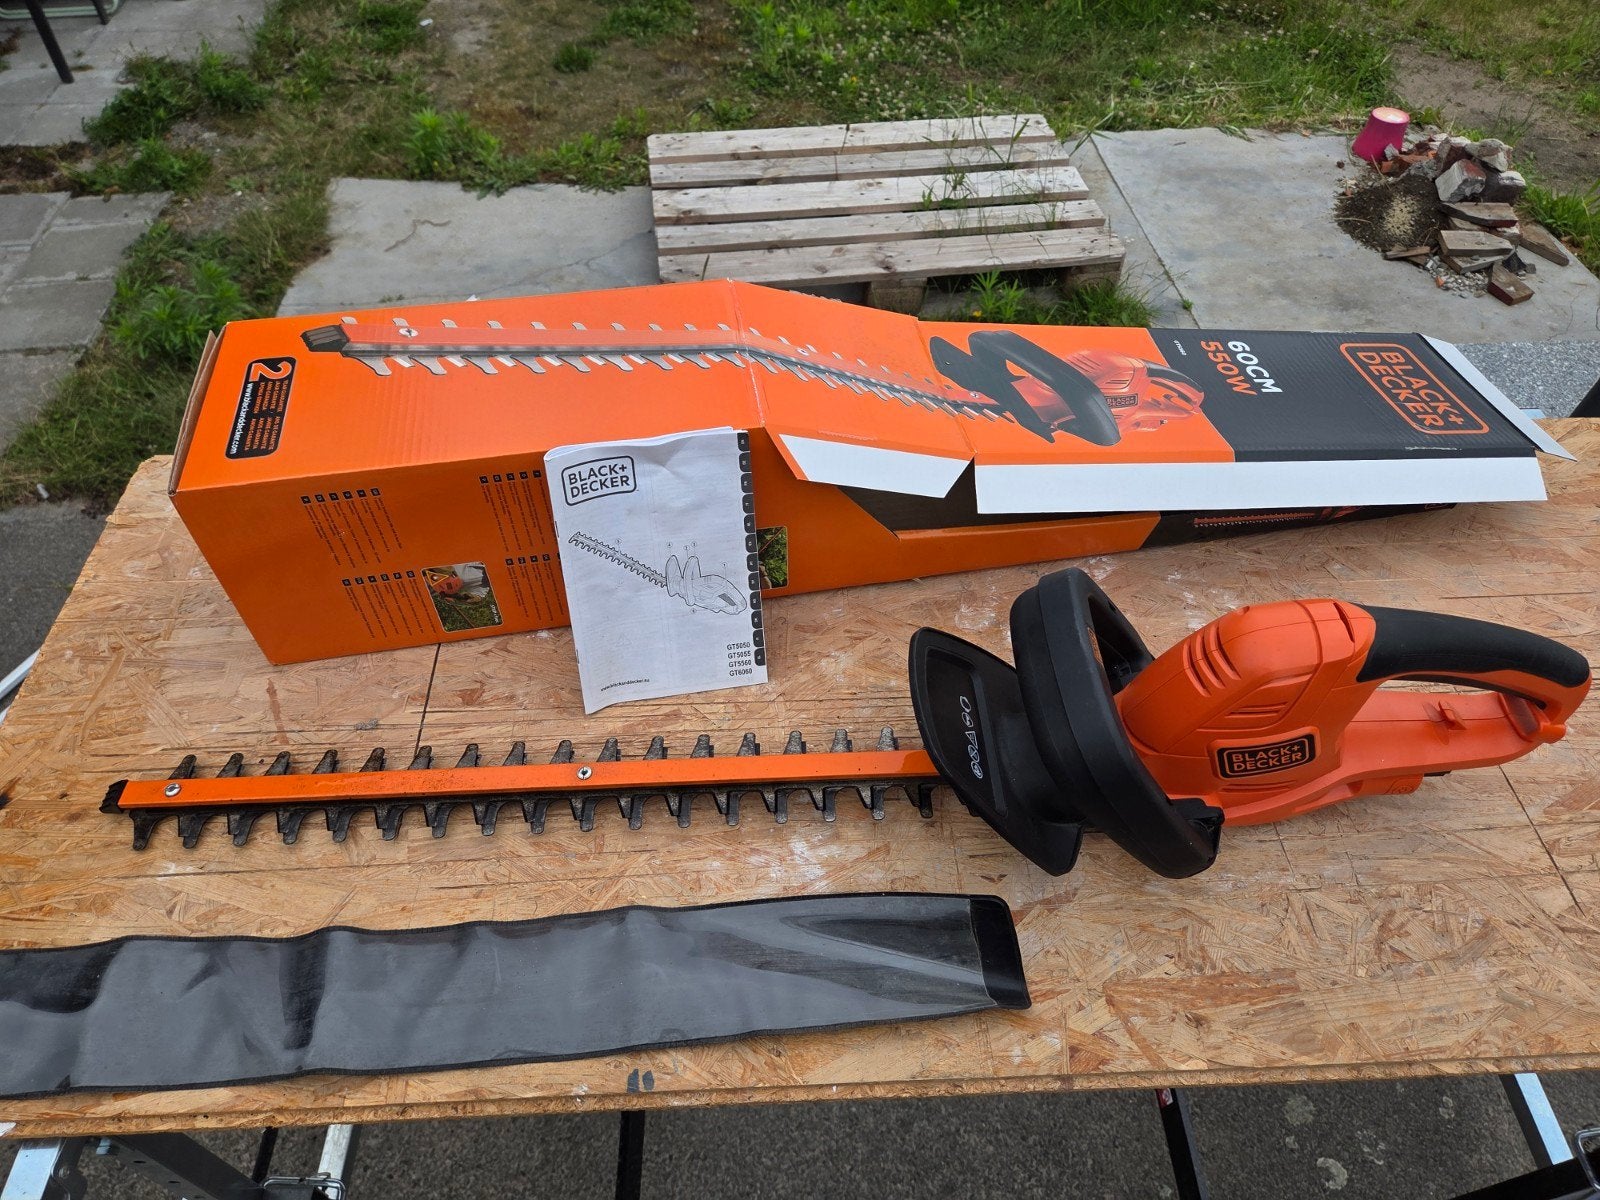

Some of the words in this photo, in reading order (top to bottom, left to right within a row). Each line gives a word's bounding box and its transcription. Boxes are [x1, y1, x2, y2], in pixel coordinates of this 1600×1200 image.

[249, 361, 292, 382] 2
[1200, 340, 1258, 396] 550W
[1227, 340, 1284, 393] 60CM
[1356, 351, 1445, 427] DECKER
[1380, 352, 1465, 425] BLACK+
[229, 382, 255, 455] www.blackanddecker.com
[568, 463, 627, 485] BLACK+
[570, 475, 631, 498] DECKER
[1232, 745, 1300, 762] BLACK+
[1233, 752, 1302, 771] DECKER
